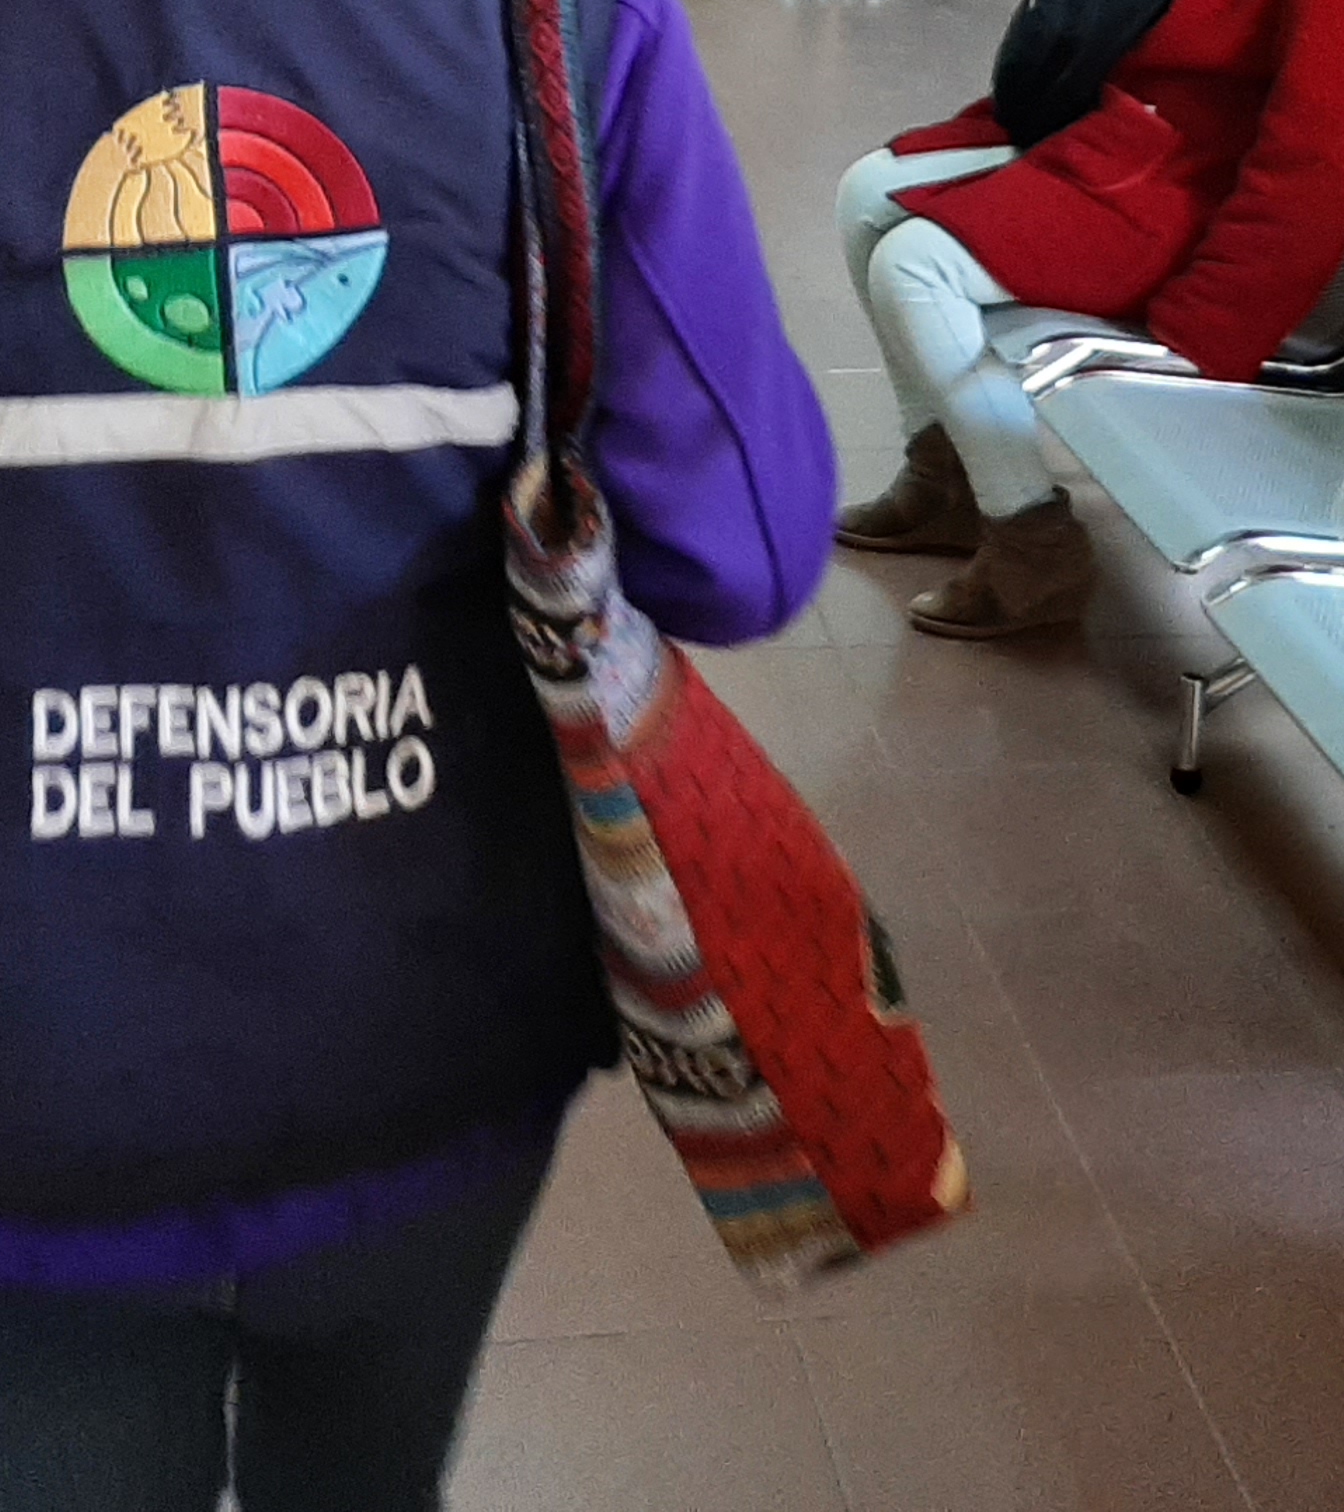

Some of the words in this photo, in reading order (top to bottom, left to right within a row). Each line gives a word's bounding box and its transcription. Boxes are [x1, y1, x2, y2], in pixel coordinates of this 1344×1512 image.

[32, 663, 433, 762] DEFENSORIA
[31, 761, 155, 840] DEL
[189, 735, 436, 840] PUEBLO
